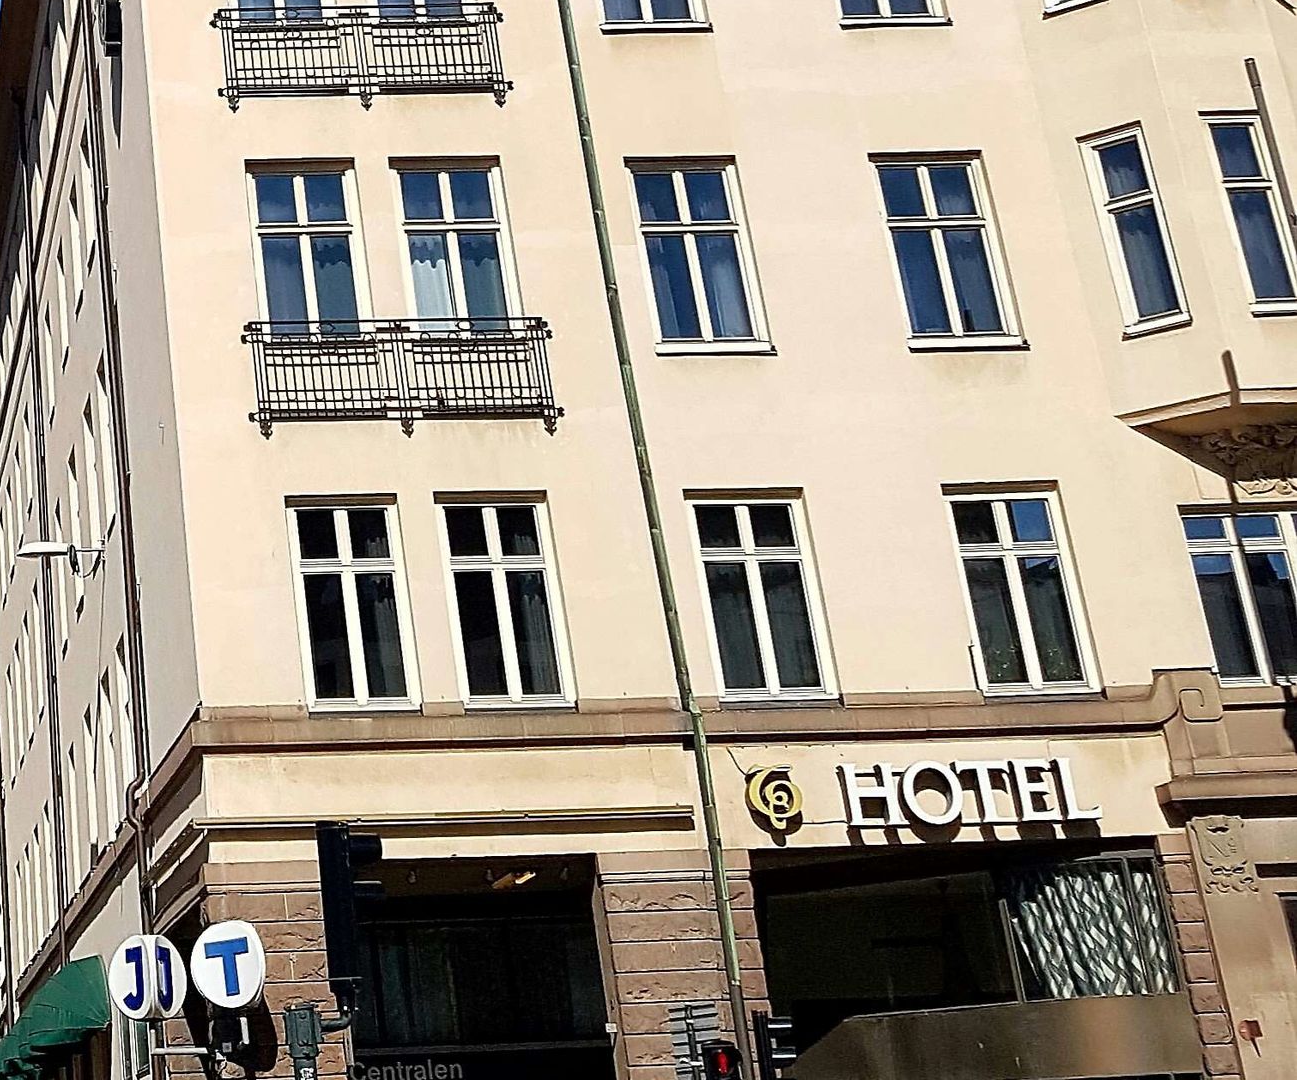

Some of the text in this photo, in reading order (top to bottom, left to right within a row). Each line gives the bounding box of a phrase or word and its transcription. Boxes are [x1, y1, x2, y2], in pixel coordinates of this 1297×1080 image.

[845, 757, 1102, 825] HOTEL
[123, 945, 145, 1011] J
[204, 936, 249, 997] T
[351, 1059, 464, 1080] Centralen
